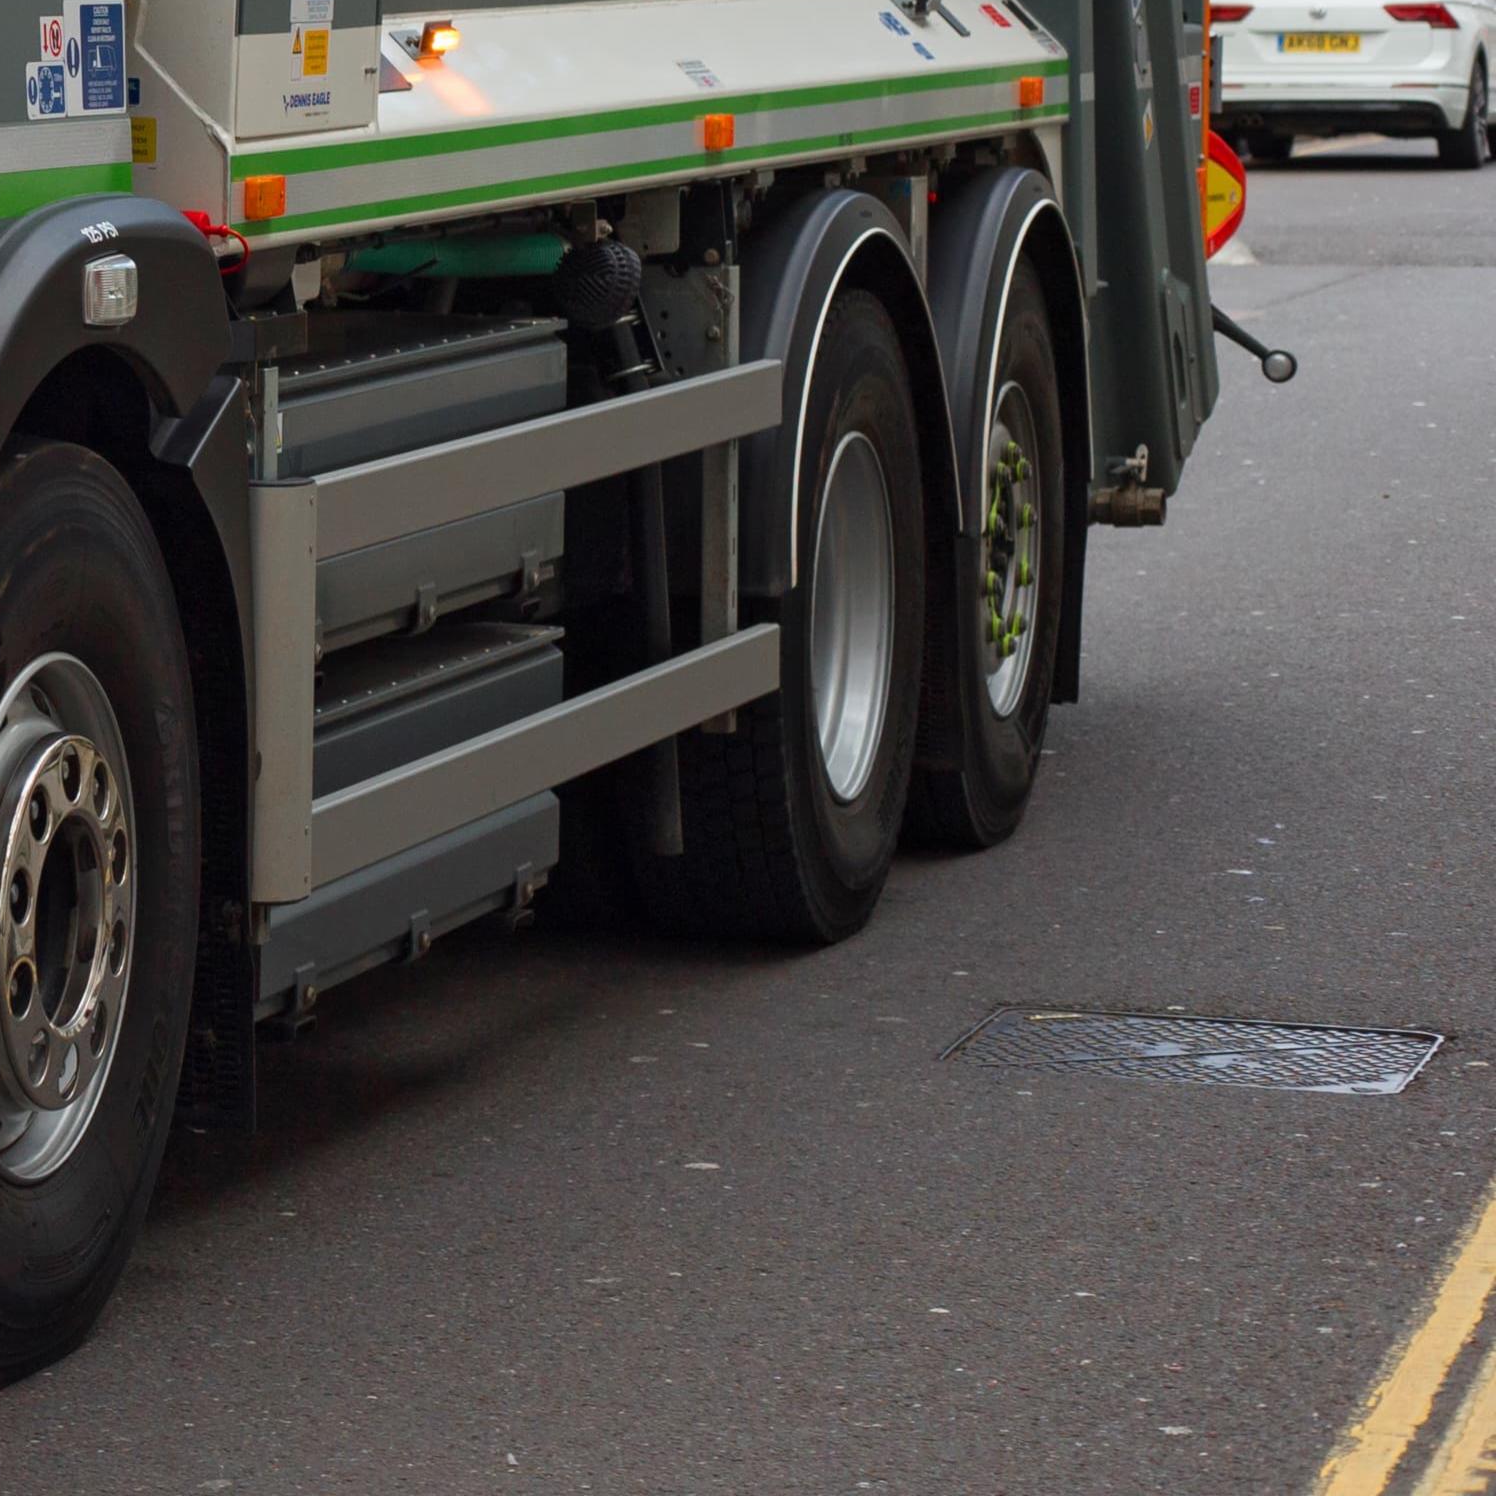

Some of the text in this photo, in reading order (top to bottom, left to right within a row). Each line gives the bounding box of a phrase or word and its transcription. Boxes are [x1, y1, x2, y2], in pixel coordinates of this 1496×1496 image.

[289, 91, 331, 109] DENNIS EAGLE
[80, 221, 120, 245] 125 PSI
